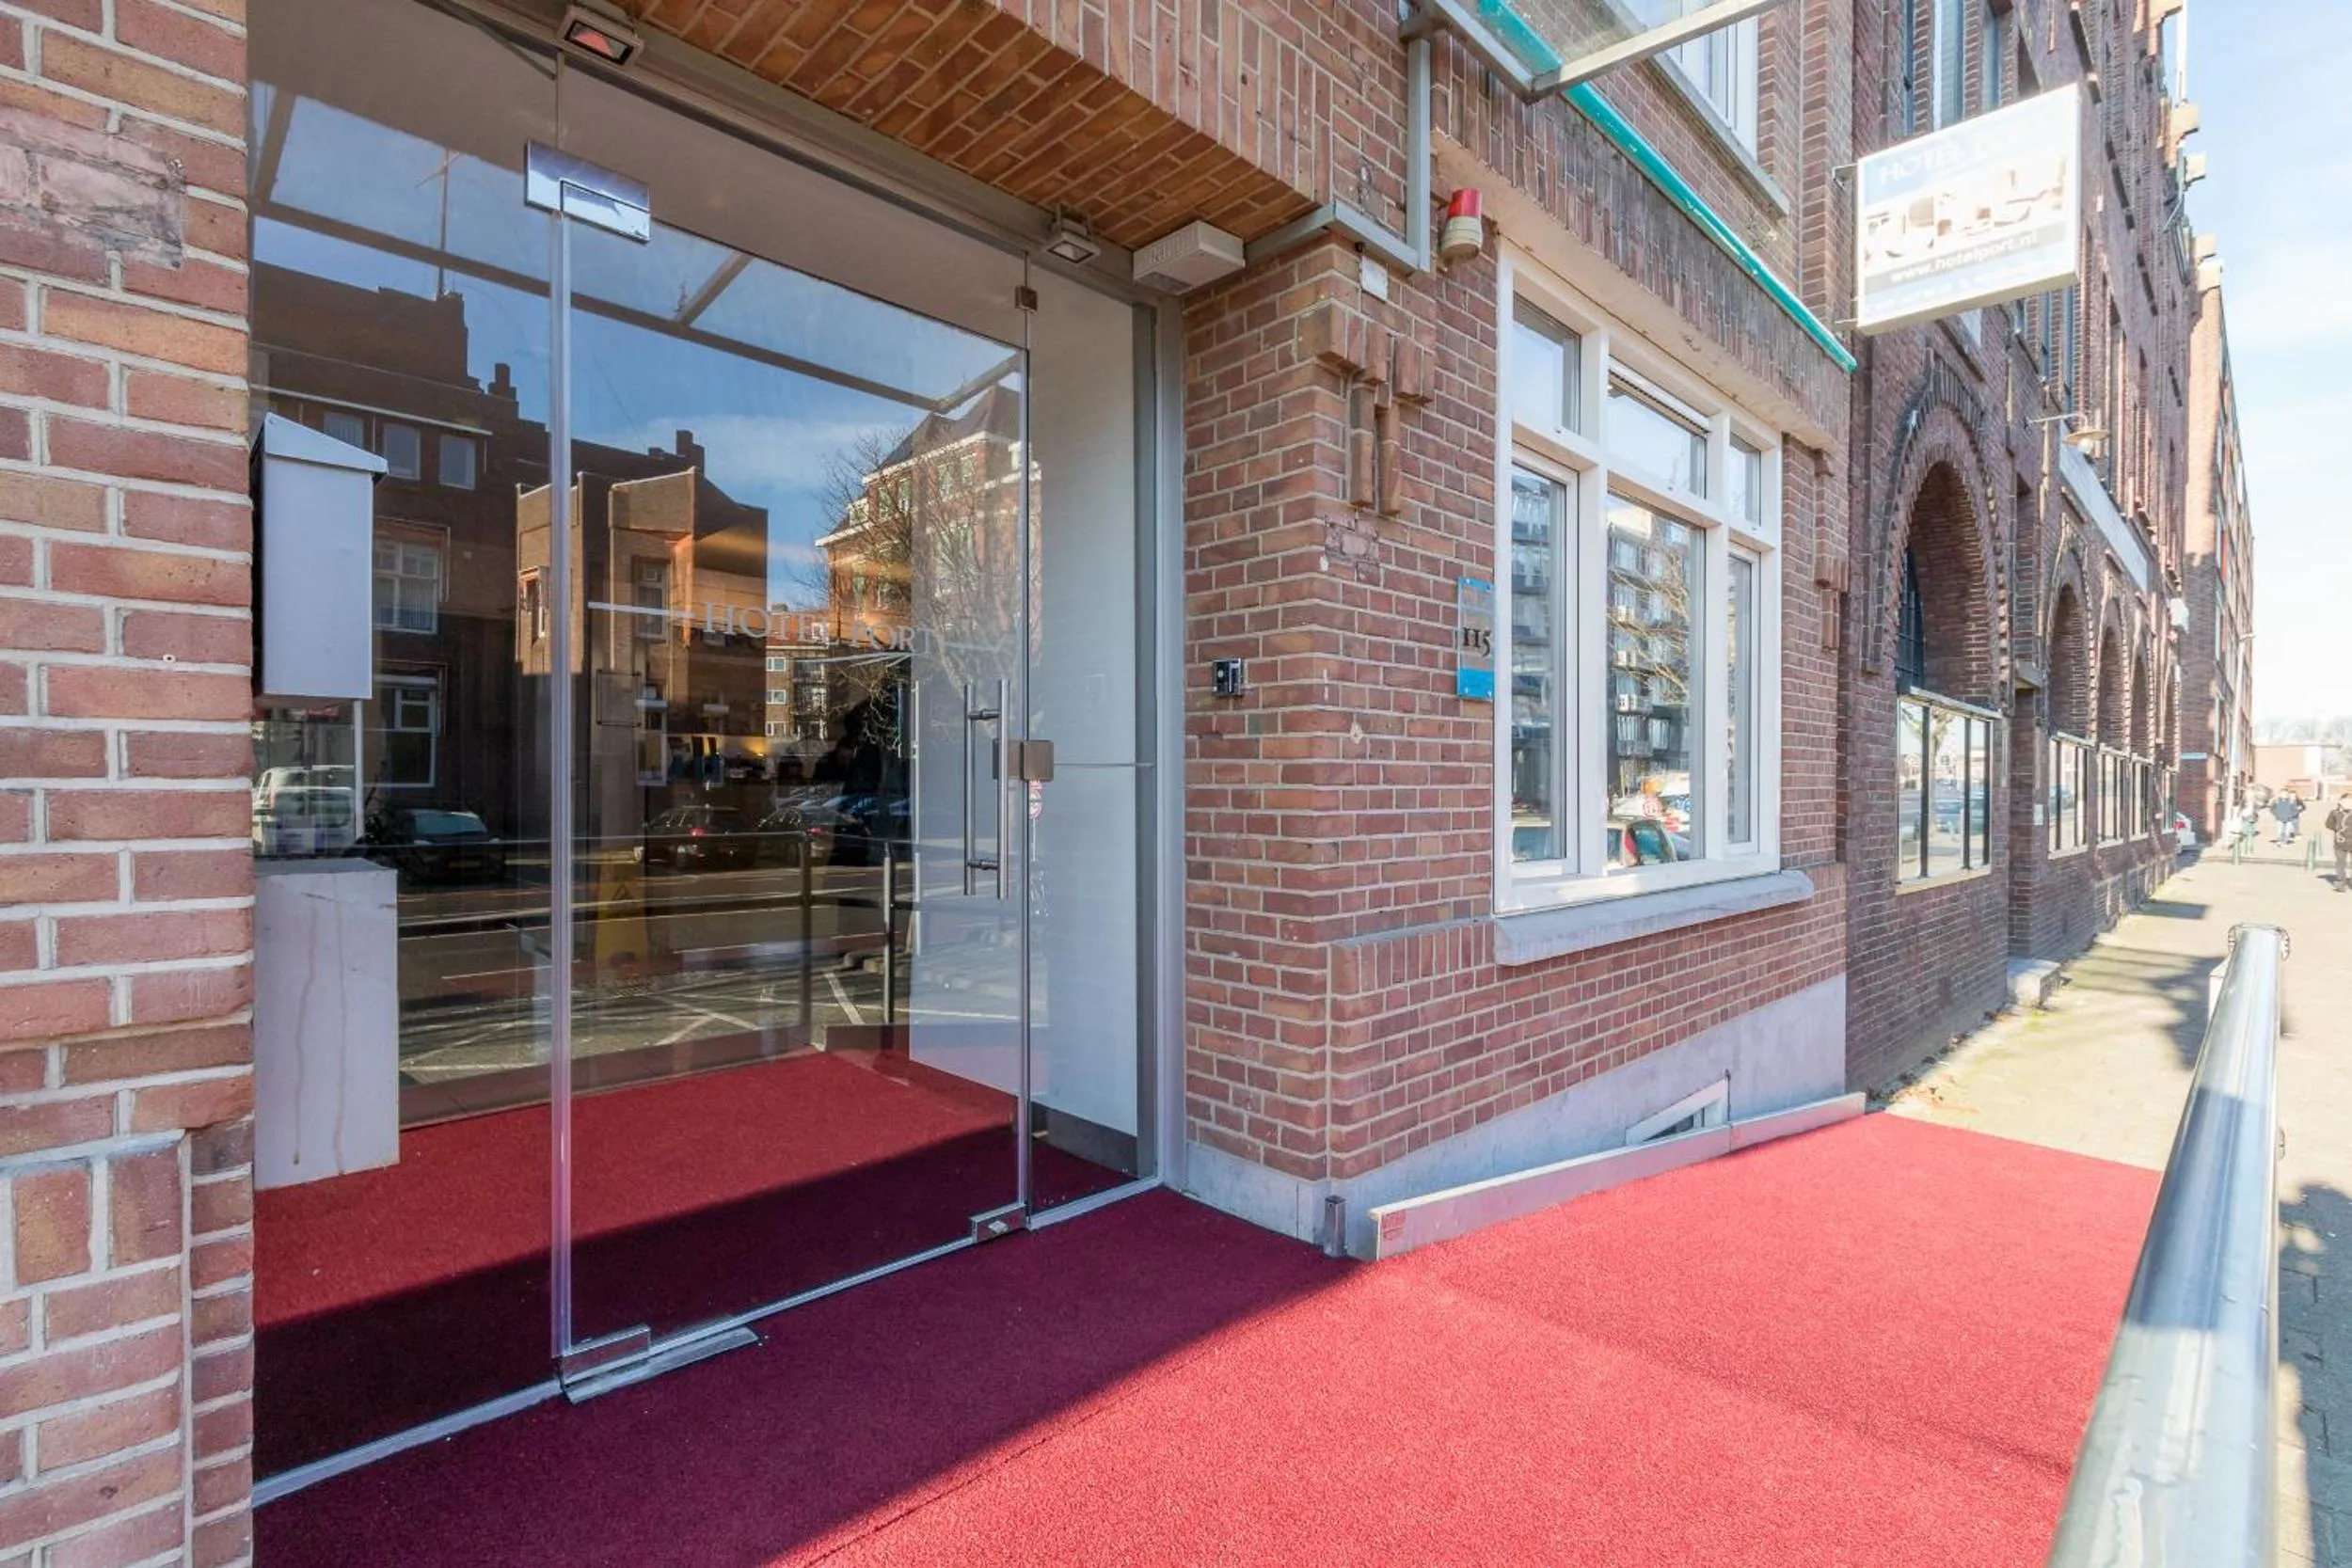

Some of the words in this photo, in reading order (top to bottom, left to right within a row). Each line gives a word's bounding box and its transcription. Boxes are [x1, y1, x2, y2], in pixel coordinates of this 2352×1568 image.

[1890, 230, 2039, 283] www.hotelport.nl
[703, 600, 840, 646] HOTEL
[849, 619, 934, 657] PORT
[1461, 626, 1492, 658] 115
